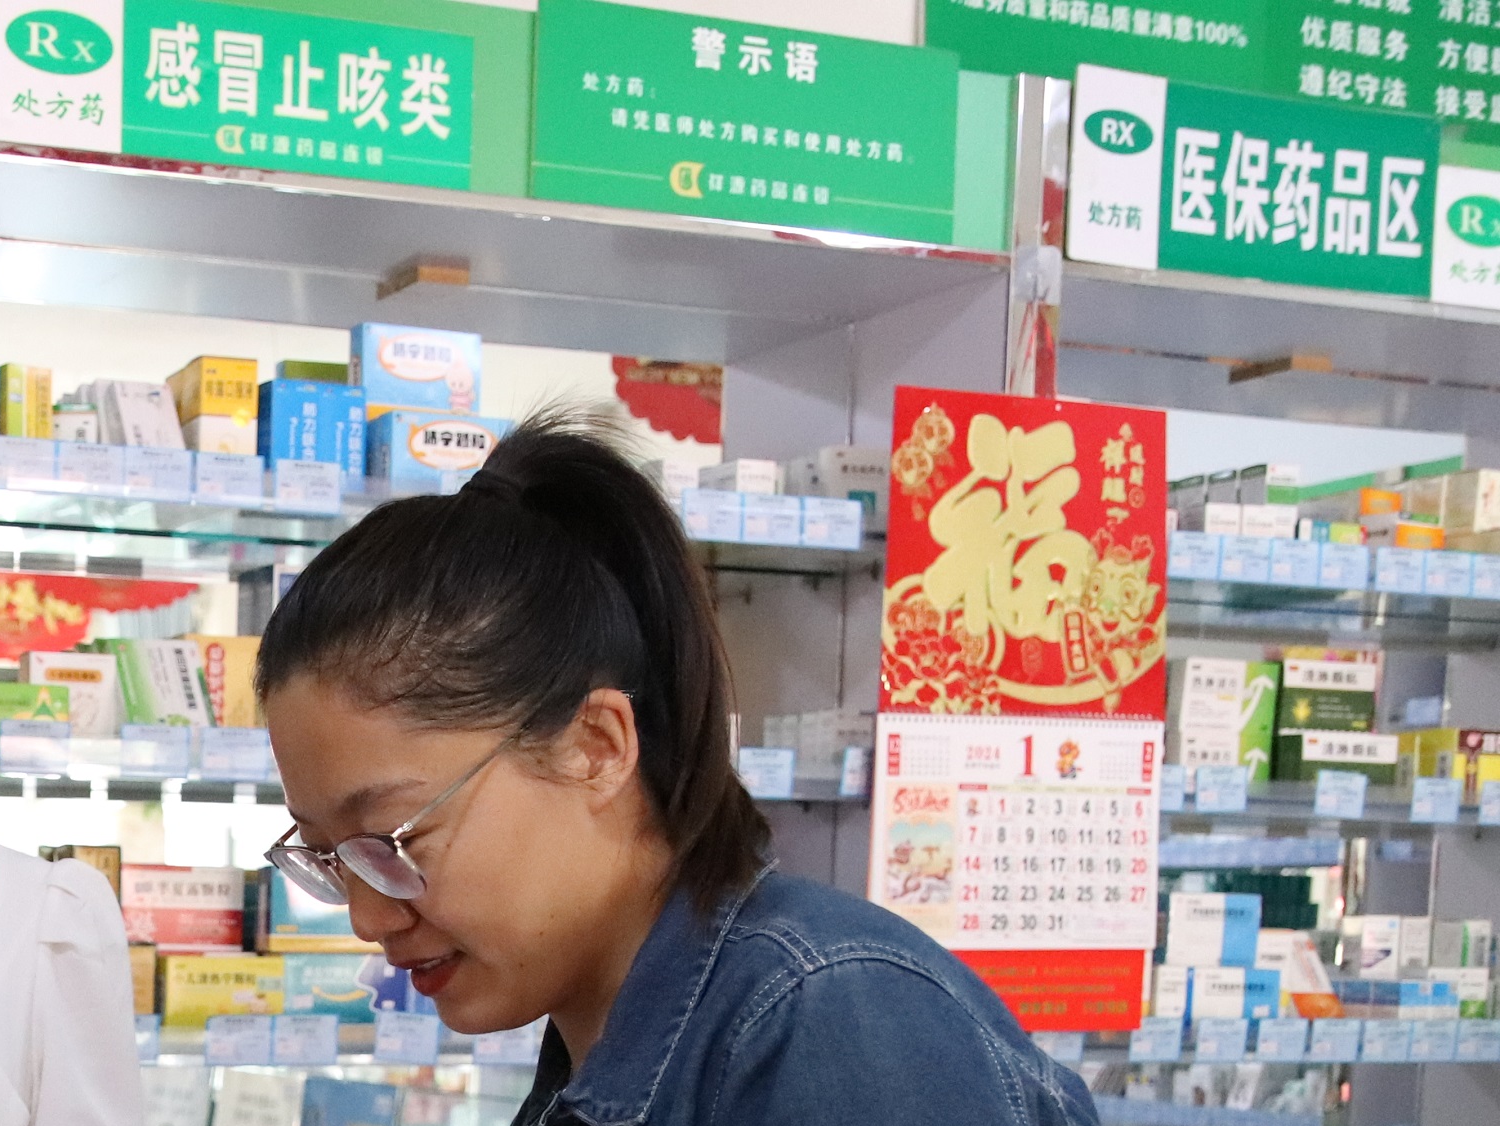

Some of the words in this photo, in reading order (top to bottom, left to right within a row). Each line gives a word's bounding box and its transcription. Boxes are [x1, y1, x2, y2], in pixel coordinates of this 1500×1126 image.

[691, 26, 819, 84] 警示语
[1300, 15, 1409, 61] 优质服务
[144, 22, 452, 140] 感冒止咳类
[1299, 63, 1408, 108] 遵纪守法
[10, 87, 106, 126] 处方药
[1100, 116, 1136, 148] RX
[1171, 127, 1426, 258] 医保药品区
[1087, 201, 1143, 231] 处方药
[1020, 734, 1034, 777] 1
[998, 799, 1006, 814] 1
[1026, 799, 1035, 815] 2
[1055, 799, 1063, 815] 3
[1082, 799, 1091, 815] 4
[1110, 800, 1118, 816] 5
[1135, 801, 1143, 817] 6
[969, 826, 977, 842] 7
[997, 827, 1006, 843] 8
[1026, 827, 1034, 843] 9
[1052, 828, 1067, 844] 10
[1079, 829, 1094, 844] 11
[1107, 829, 1122, 845] 12
[1132, 830, 1147, 845] 13
[964, 856, 980, 871] 14
[993, 856, 1009, 872] 15
[1022, 857, 1038, 872] 16
[1050, 857, 1066, 872] 17
[1079, 858, 1094, 873] 18
[1106, 858, 1121, 873] 19
[1131, 858, 1147, 873] 20
[963, 885, 979, 900] 21
[992, 885, 1008, 901] 22
[1021, 886, 1037, 901] 23
[1049, 886, 1065, 901] 24
[1077, 887, 1093, 902] 25
[1105, 887, 1121, 901] 26
[1130, 887, 1146, 901] 27
[963, 914, 979, 930] 28
[992, 915, 1008, 931] 29
[1020, 915, 1037, 931] 30
[1048, 915, 1064, 930] 31
